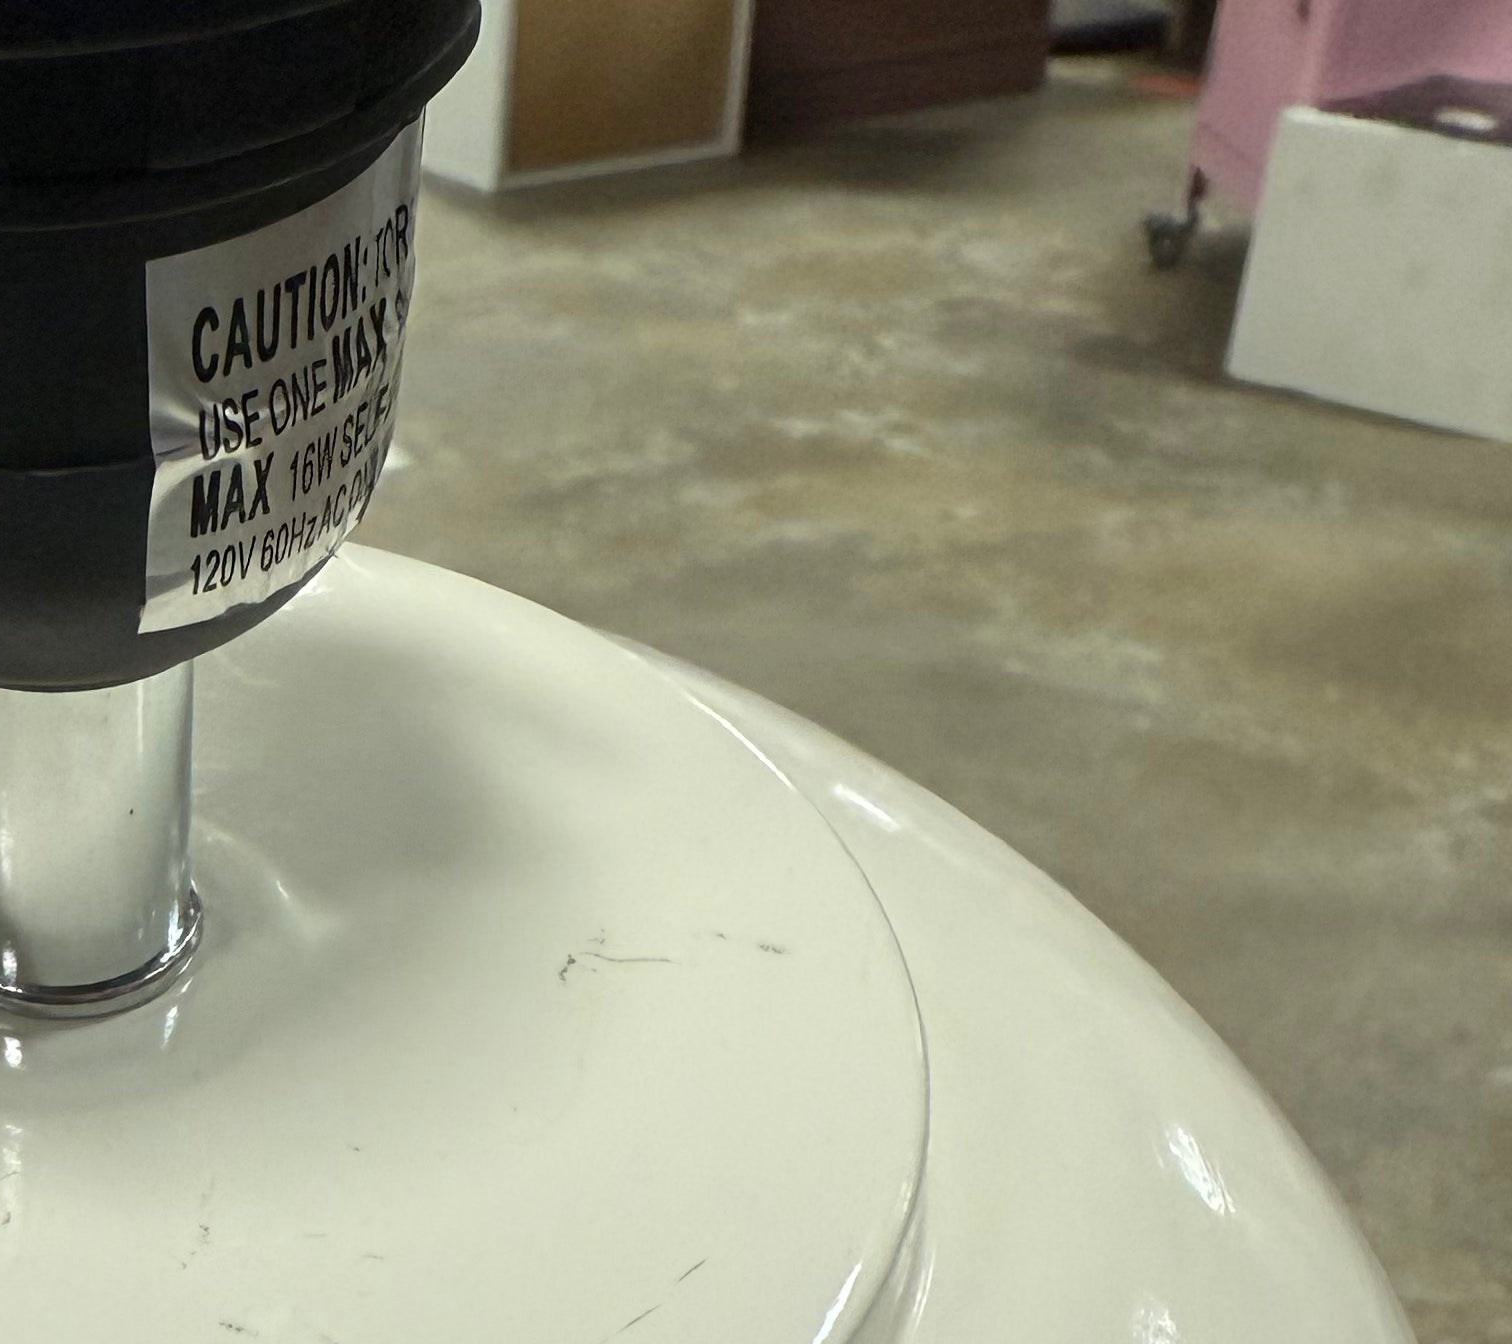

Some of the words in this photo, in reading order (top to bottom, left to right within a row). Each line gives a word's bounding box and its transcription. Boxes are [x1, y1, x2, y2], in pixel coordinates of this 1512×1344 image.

[192, 235, 368, 383] CAUTION:
[199, 389, 263, 460] USE
[269, 358, 328, 436] ONE
[333, 297, 387, 404] MAX
[190, 452, 274, 538] MAX
[290, 427, 337, 501] 16W
[190, 535, 256, 595] 120V
[260, 512, 318, 572] 60Hz
[317, 484, 347, 541] AC
